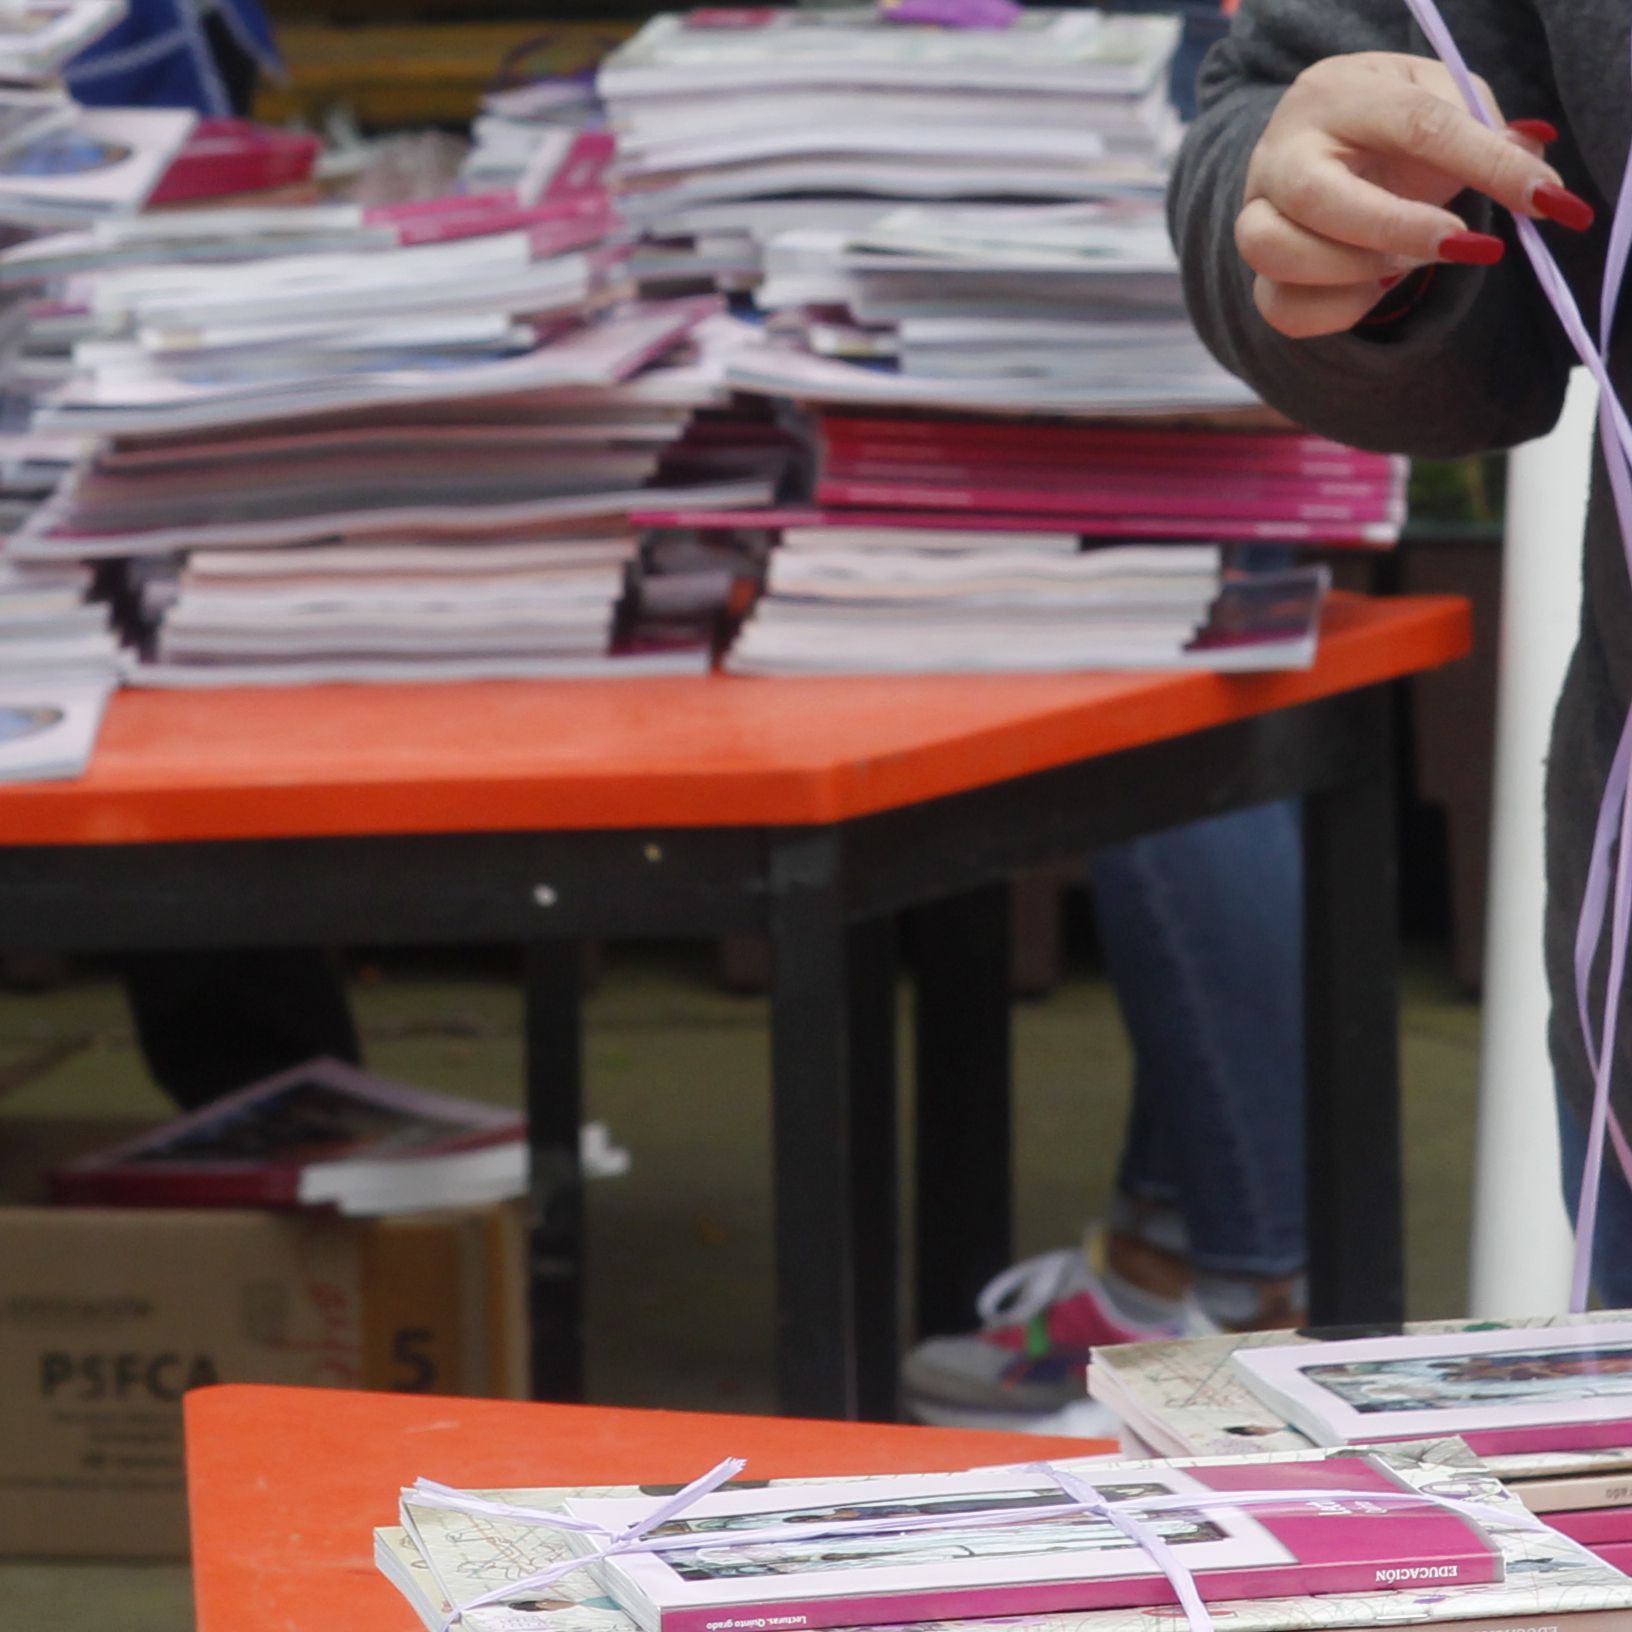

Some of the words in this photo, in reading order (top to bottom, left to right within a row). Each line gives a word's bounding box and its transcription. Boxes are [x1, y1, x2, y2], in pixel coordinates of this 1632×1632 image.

[392, 1327, 437, 1392] 5
[1375, 1565, 1458, 1584] EDUCACIÓN
[706, 1619, 733, 1631] grado
[734, 1618, 766, 1628] Quinto
